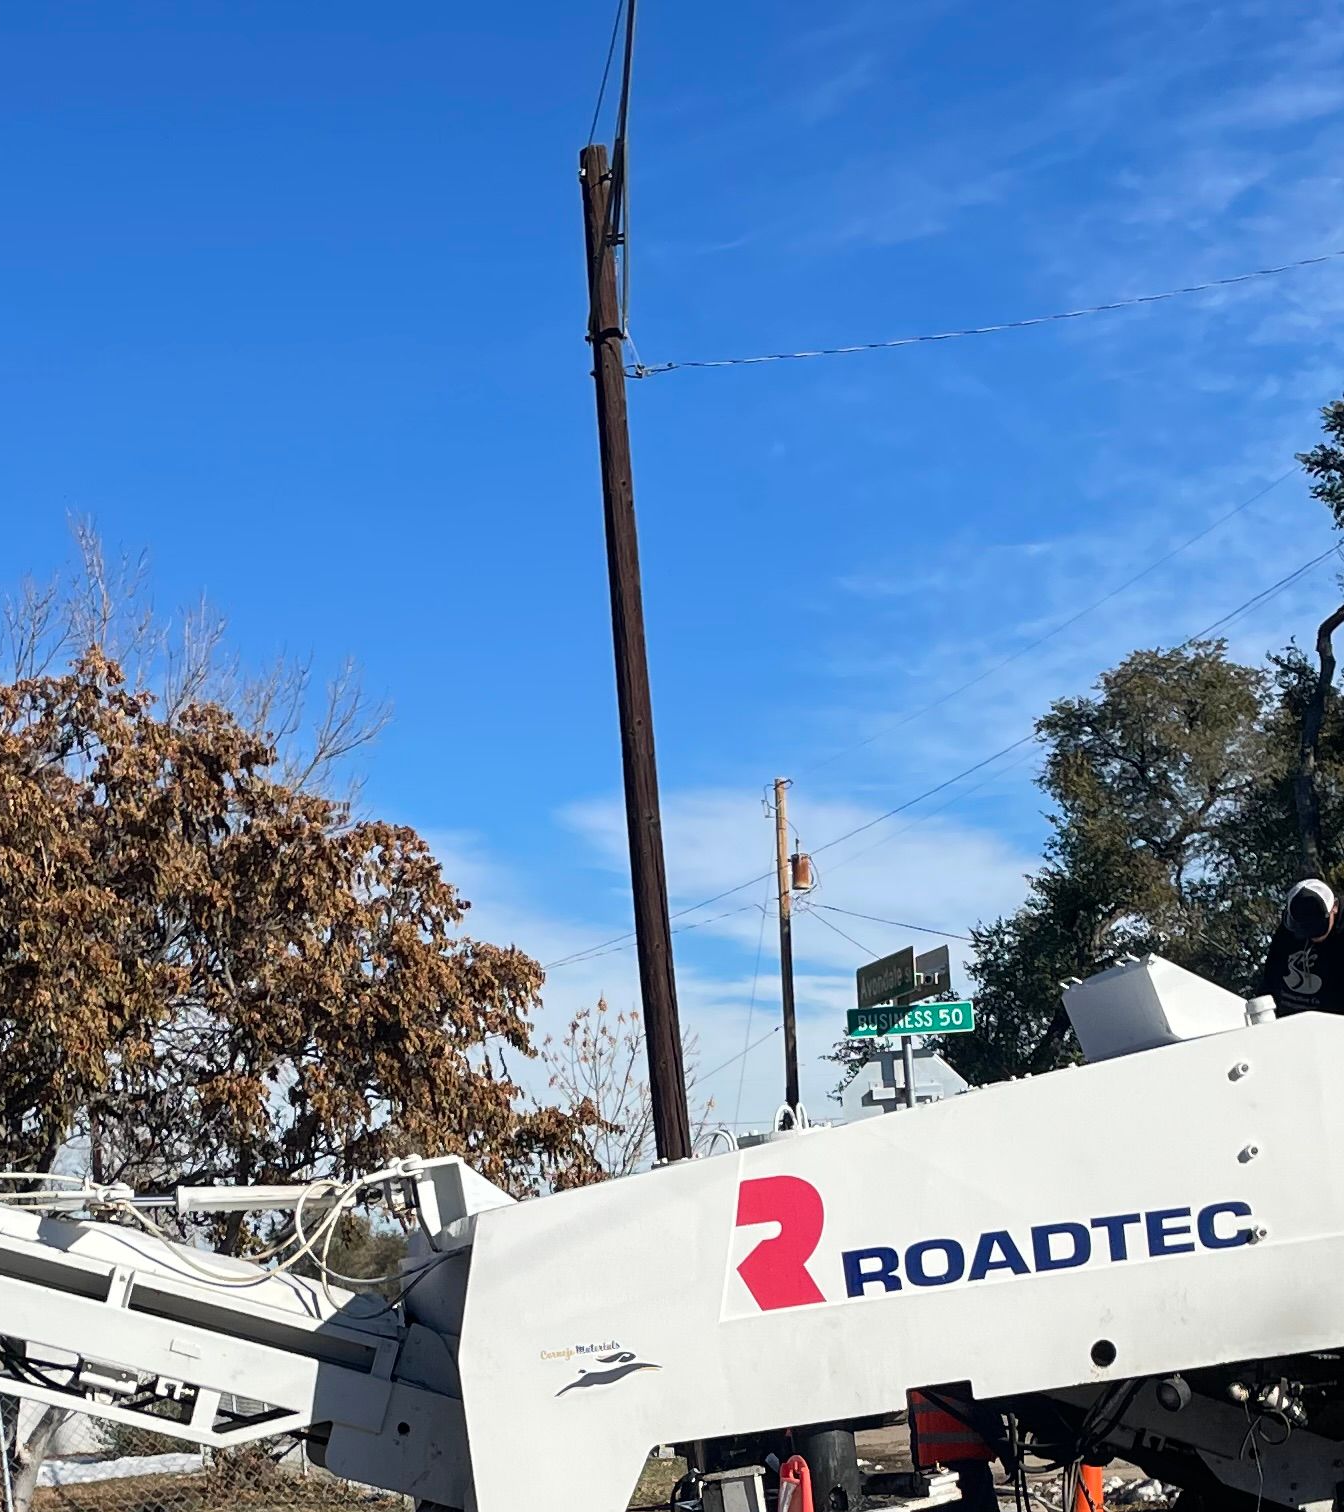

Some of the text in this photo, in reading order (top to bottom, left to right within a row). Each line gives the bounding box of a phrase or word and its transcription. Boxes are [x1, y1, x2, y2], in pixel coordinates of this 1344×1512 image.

[857, 1007, 964, 1032] BUSINESS 50
[841, 1200, 1254, 1299] ROADTEC
